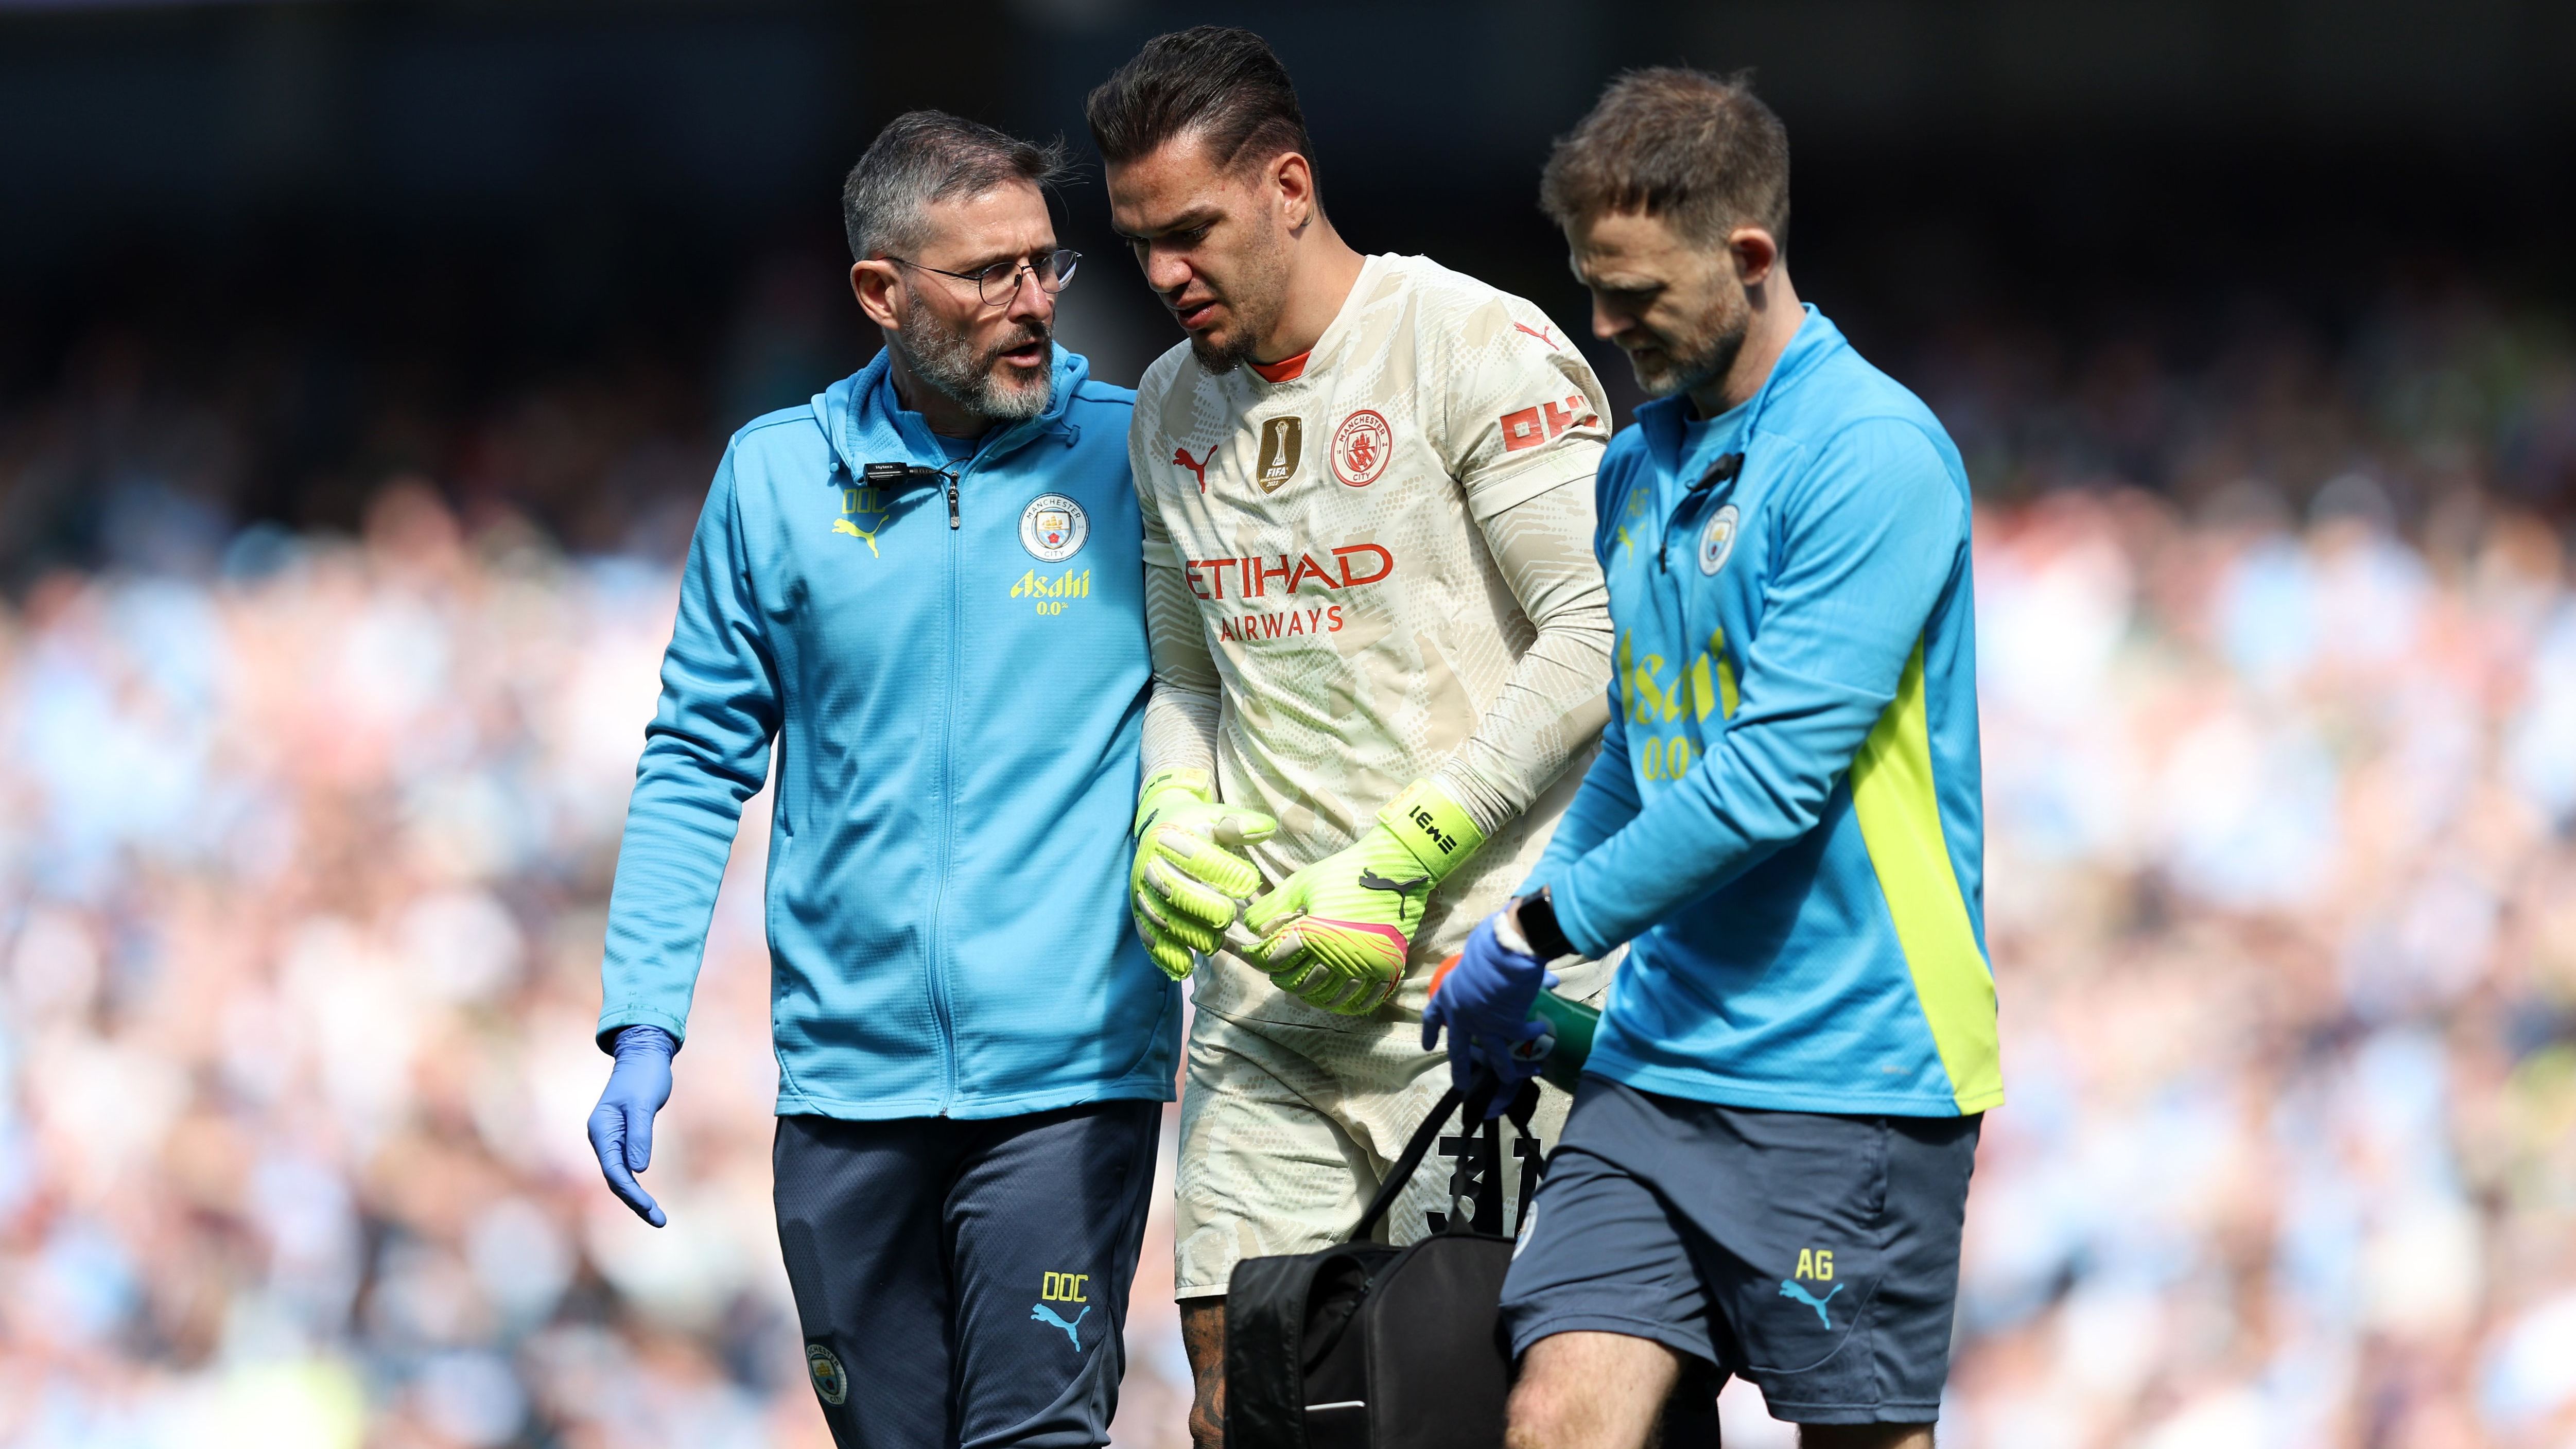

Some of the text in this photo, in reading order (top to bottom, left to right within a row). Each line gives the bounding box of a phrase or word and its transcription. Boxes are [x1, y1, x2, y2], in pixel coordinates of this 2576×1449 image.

[1339, 416, 1385, 442] MANCHESTER
[1500, 395, 1598, 452] OK
[1266, 467, 1286, 478] FIFA
[1353, 472, 1371, 481] CITY
[842, 487, 886, 514] DOC
[1026, 498, 1081, 519] MANCHESTER
[1010, 568, 1090, 599] Asahi
[1186, 544, 1394, 600] ETIHAD
[1036, 601, 1069, 616] 0.0%
[1220, 605, 1344, 642] AIRWAYS
[1408, 805, 1457, 855] EM31
[1795, 1248, 1833, 1281] AG
[1042, 1271, 1089, 1302] DOC
